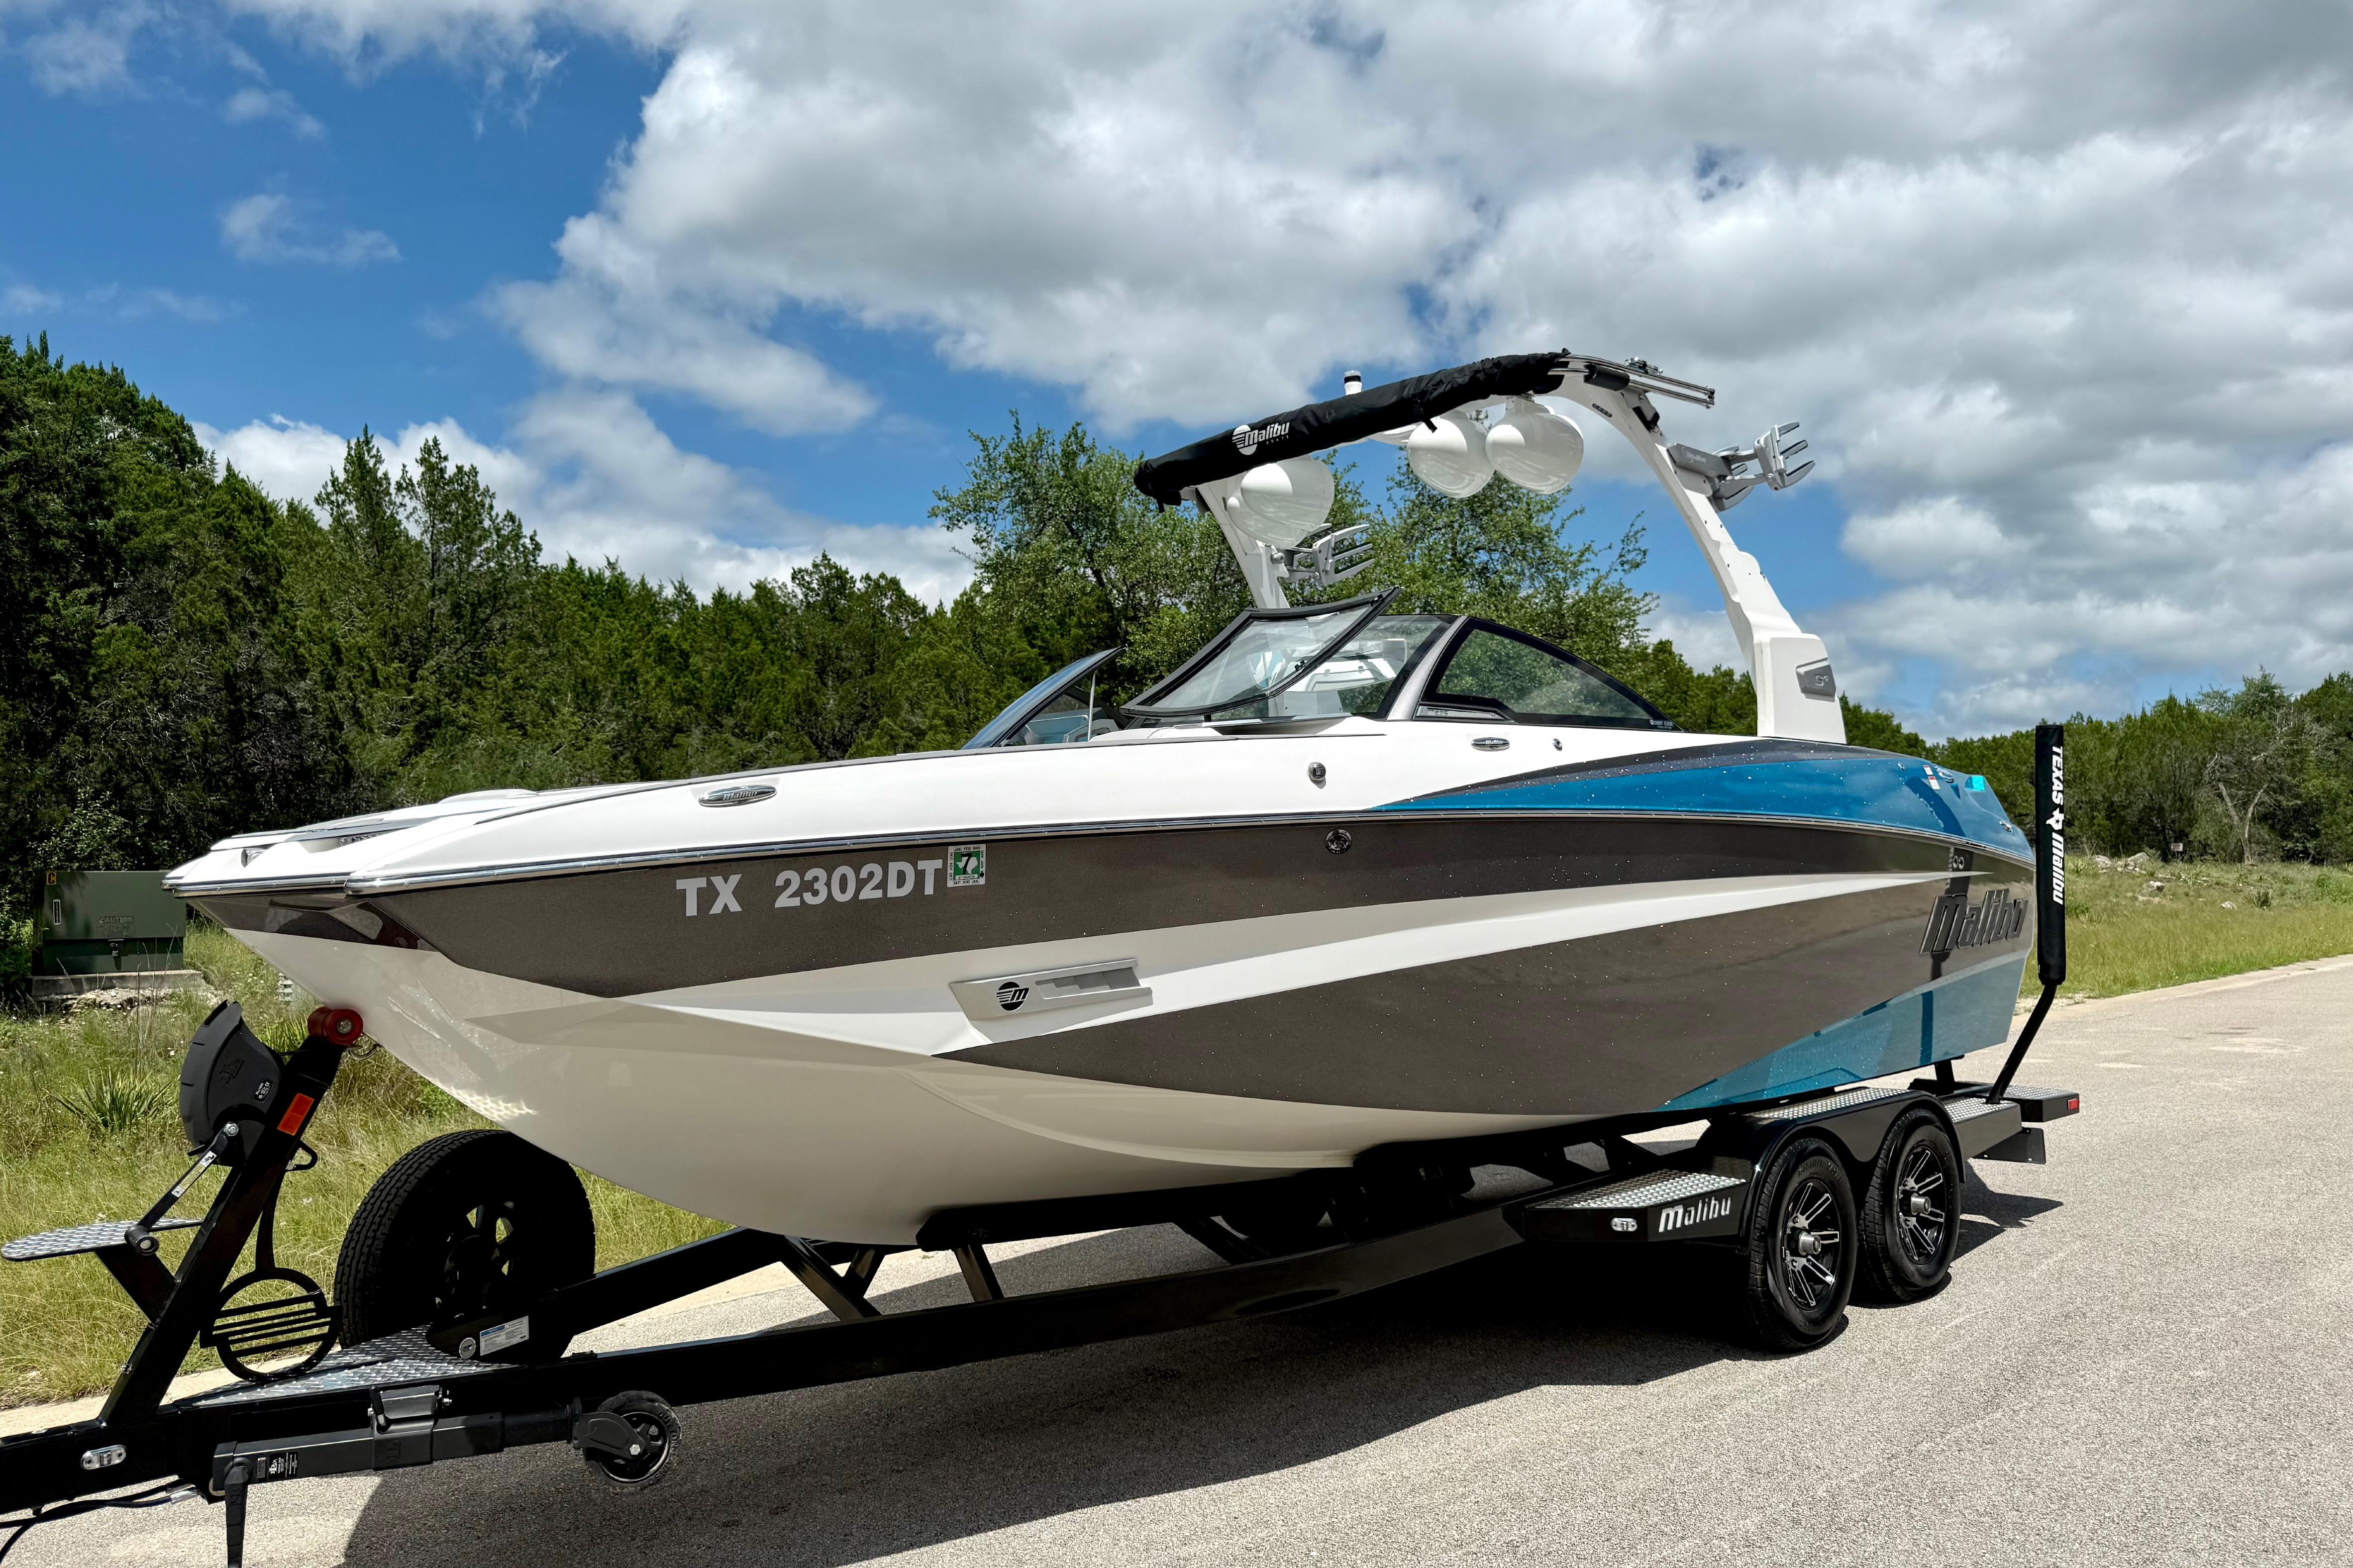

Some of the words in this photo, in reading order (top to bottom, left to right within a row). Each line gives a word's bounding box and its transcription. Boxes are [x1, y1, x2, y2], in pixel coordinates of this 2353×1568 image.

[1244, 422, 1290, 446] Malibu
[2052, 746, 2063, 806] TEXAS
[676, 874, 743, 917] TX
[774, 859, 943, 908] 2302DT
[961, 852, 972, 875] 7
[2052, 832, 2064, 905] Malibu
[1919, 888, 2029, 955] Malibu
[1658, 1196, 1731, 1233] Malibu
